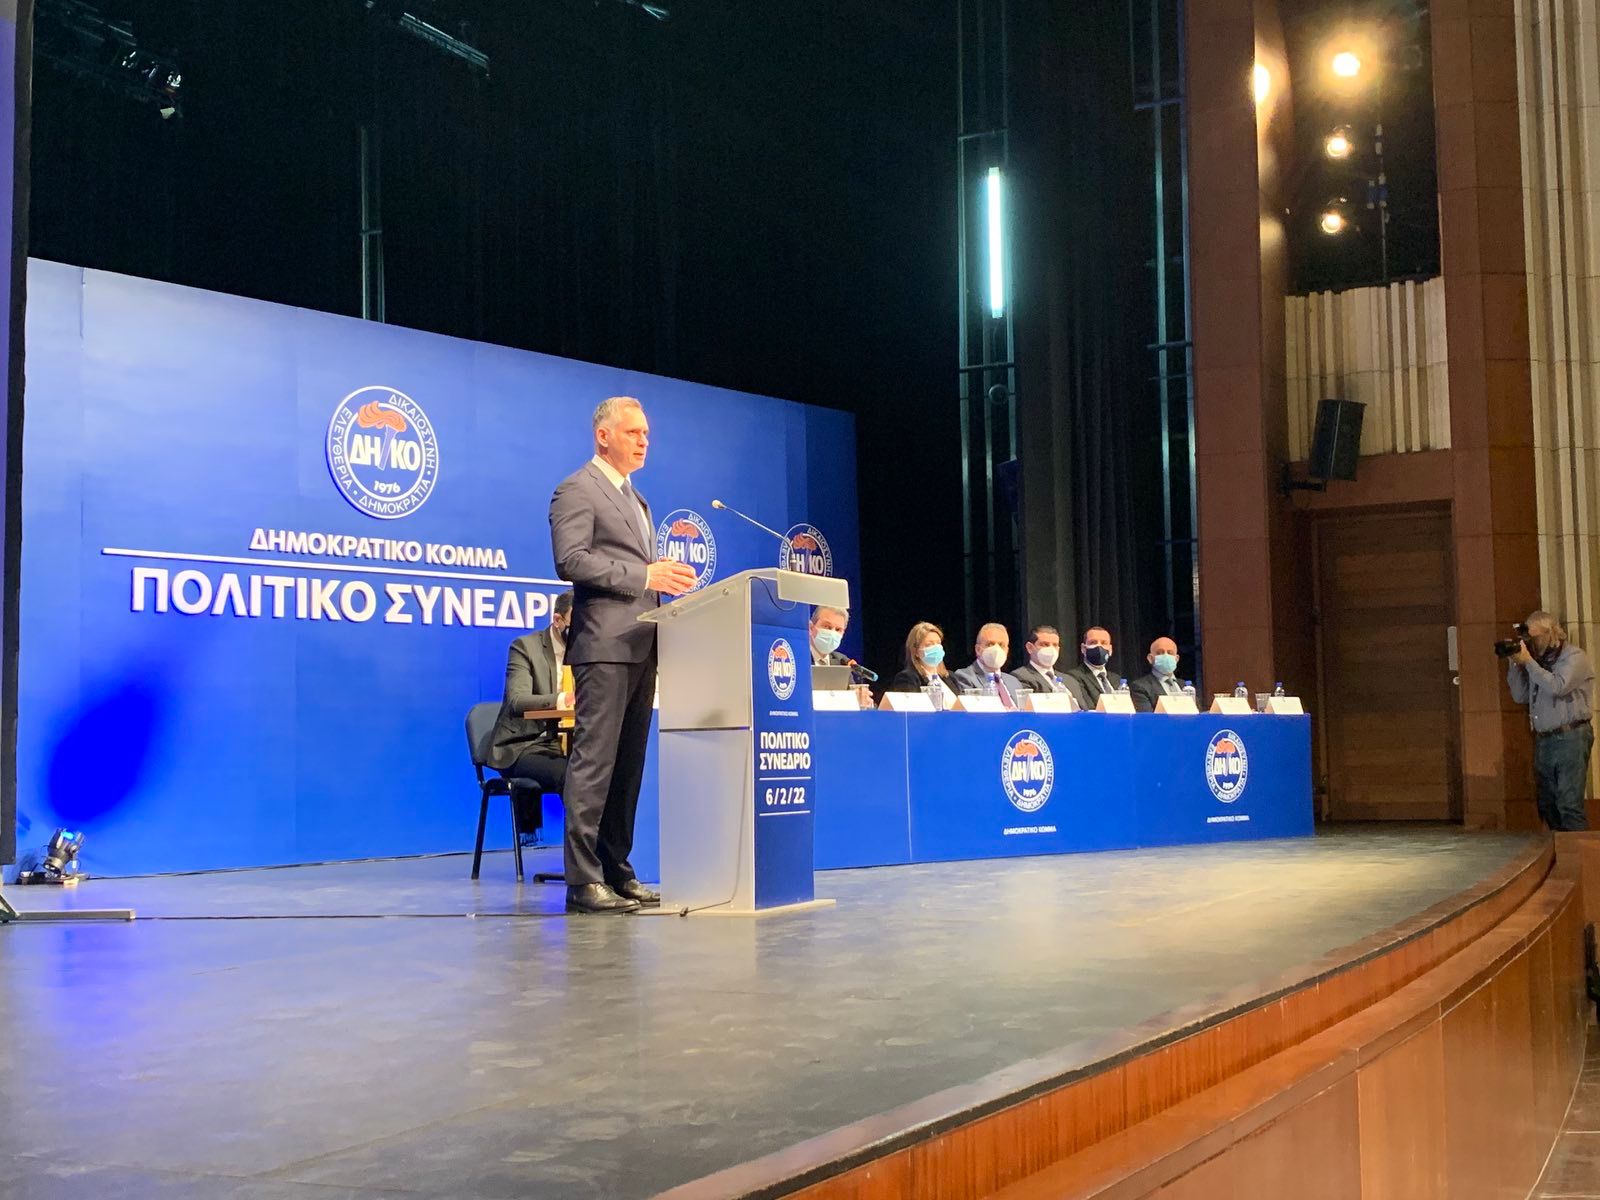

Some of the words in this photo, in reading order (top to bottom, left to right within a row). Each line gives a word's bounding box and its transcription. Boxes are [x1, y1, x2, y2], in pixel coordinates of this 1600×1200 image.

[332, 406, 354, 490] ΕΛΕΥΘΕΡΙΑ
[388, 394, 436, 469] ΔΙΚΑΙΟΣΥΝΗ
[358, 479, 431, 514] ΔΗΜΟΚΡΑΤΙΑ
[373, 480, 401, 494] 1976
[249, 528, 423, 563] ΔΗΜΟΚΡΑΤΙΚΟ
[426, 543, 508, 570] ΚΟΜΜΑ
[131, 567, 377, 623] ΠΟΛΙΤΙΚΟ
[760, 732, 810, 749] ΠΟΛΙΤΙΚΟ
[760, 752, 811, 770] ΣΥΝΕΔΡΙΟ
